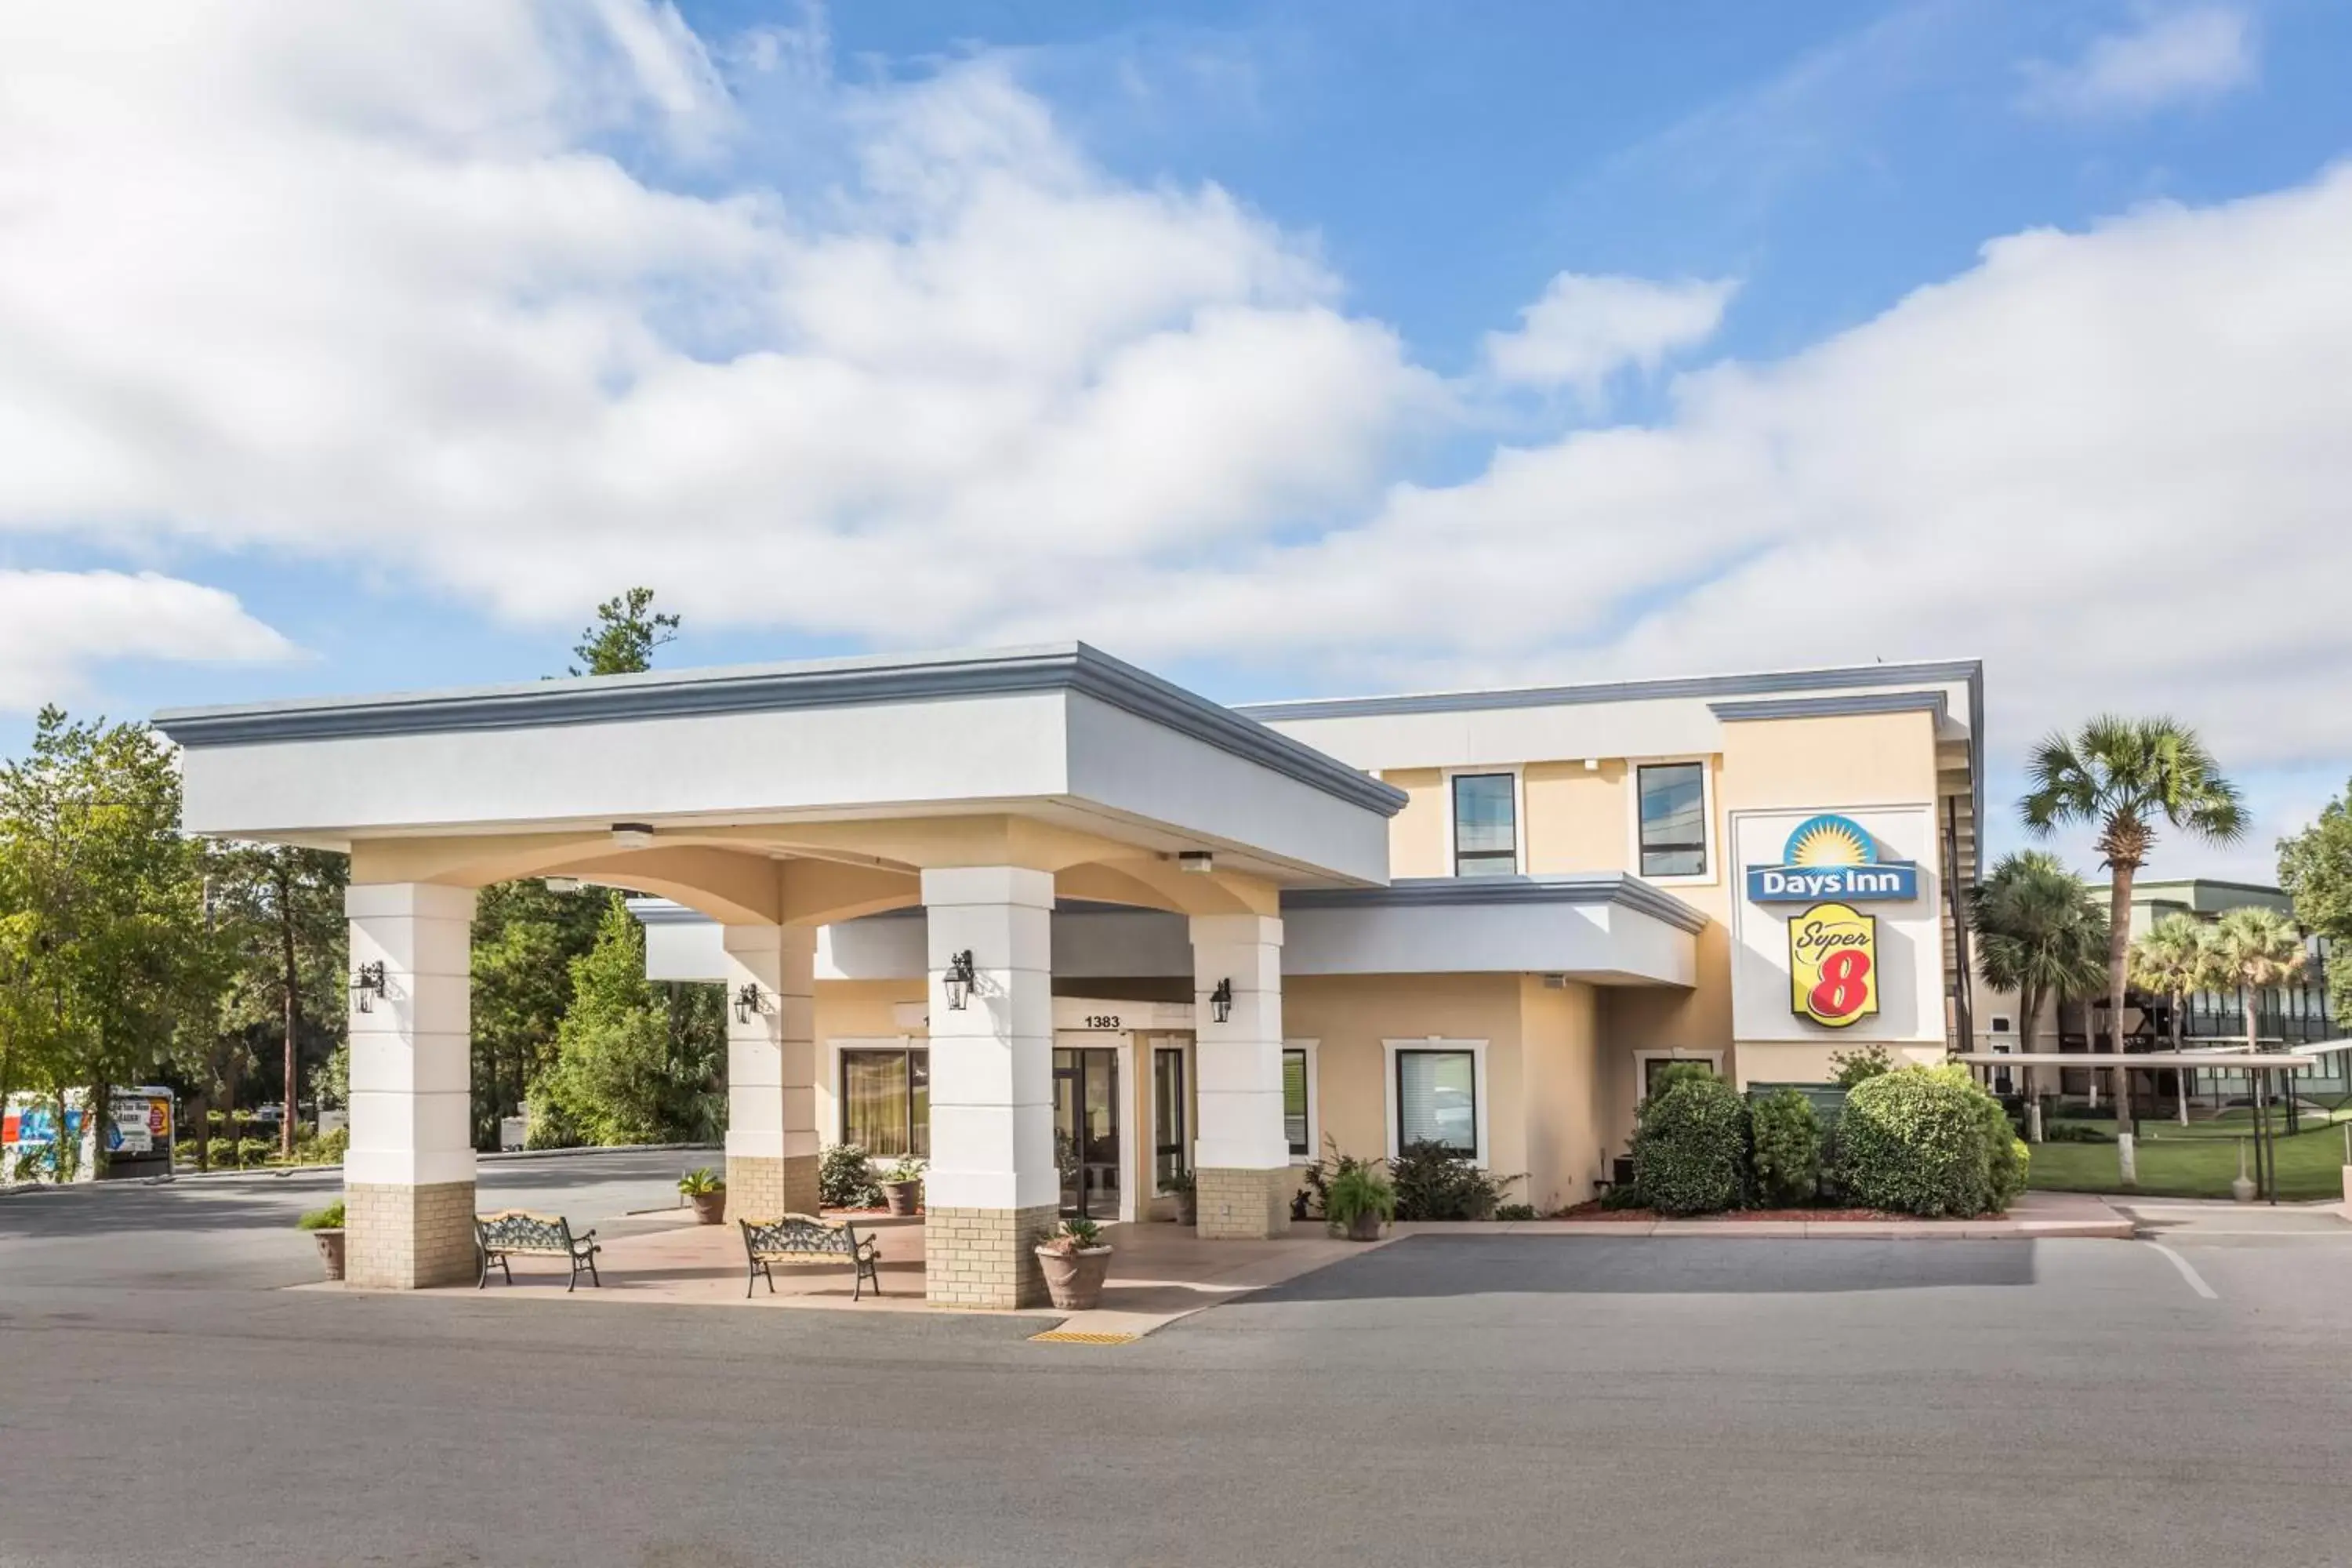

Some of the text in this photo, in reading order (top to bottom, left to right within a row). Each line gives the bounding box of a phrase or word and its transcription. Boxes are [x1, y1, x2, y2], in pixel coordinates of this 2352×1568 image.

[1763, 870, 1900, 897] Days Inn
[1796, 920, 1871, 961] Super
[1807, 949, 1871, 1018] 8
[1084, 1015, 1120, 1028] 1383
